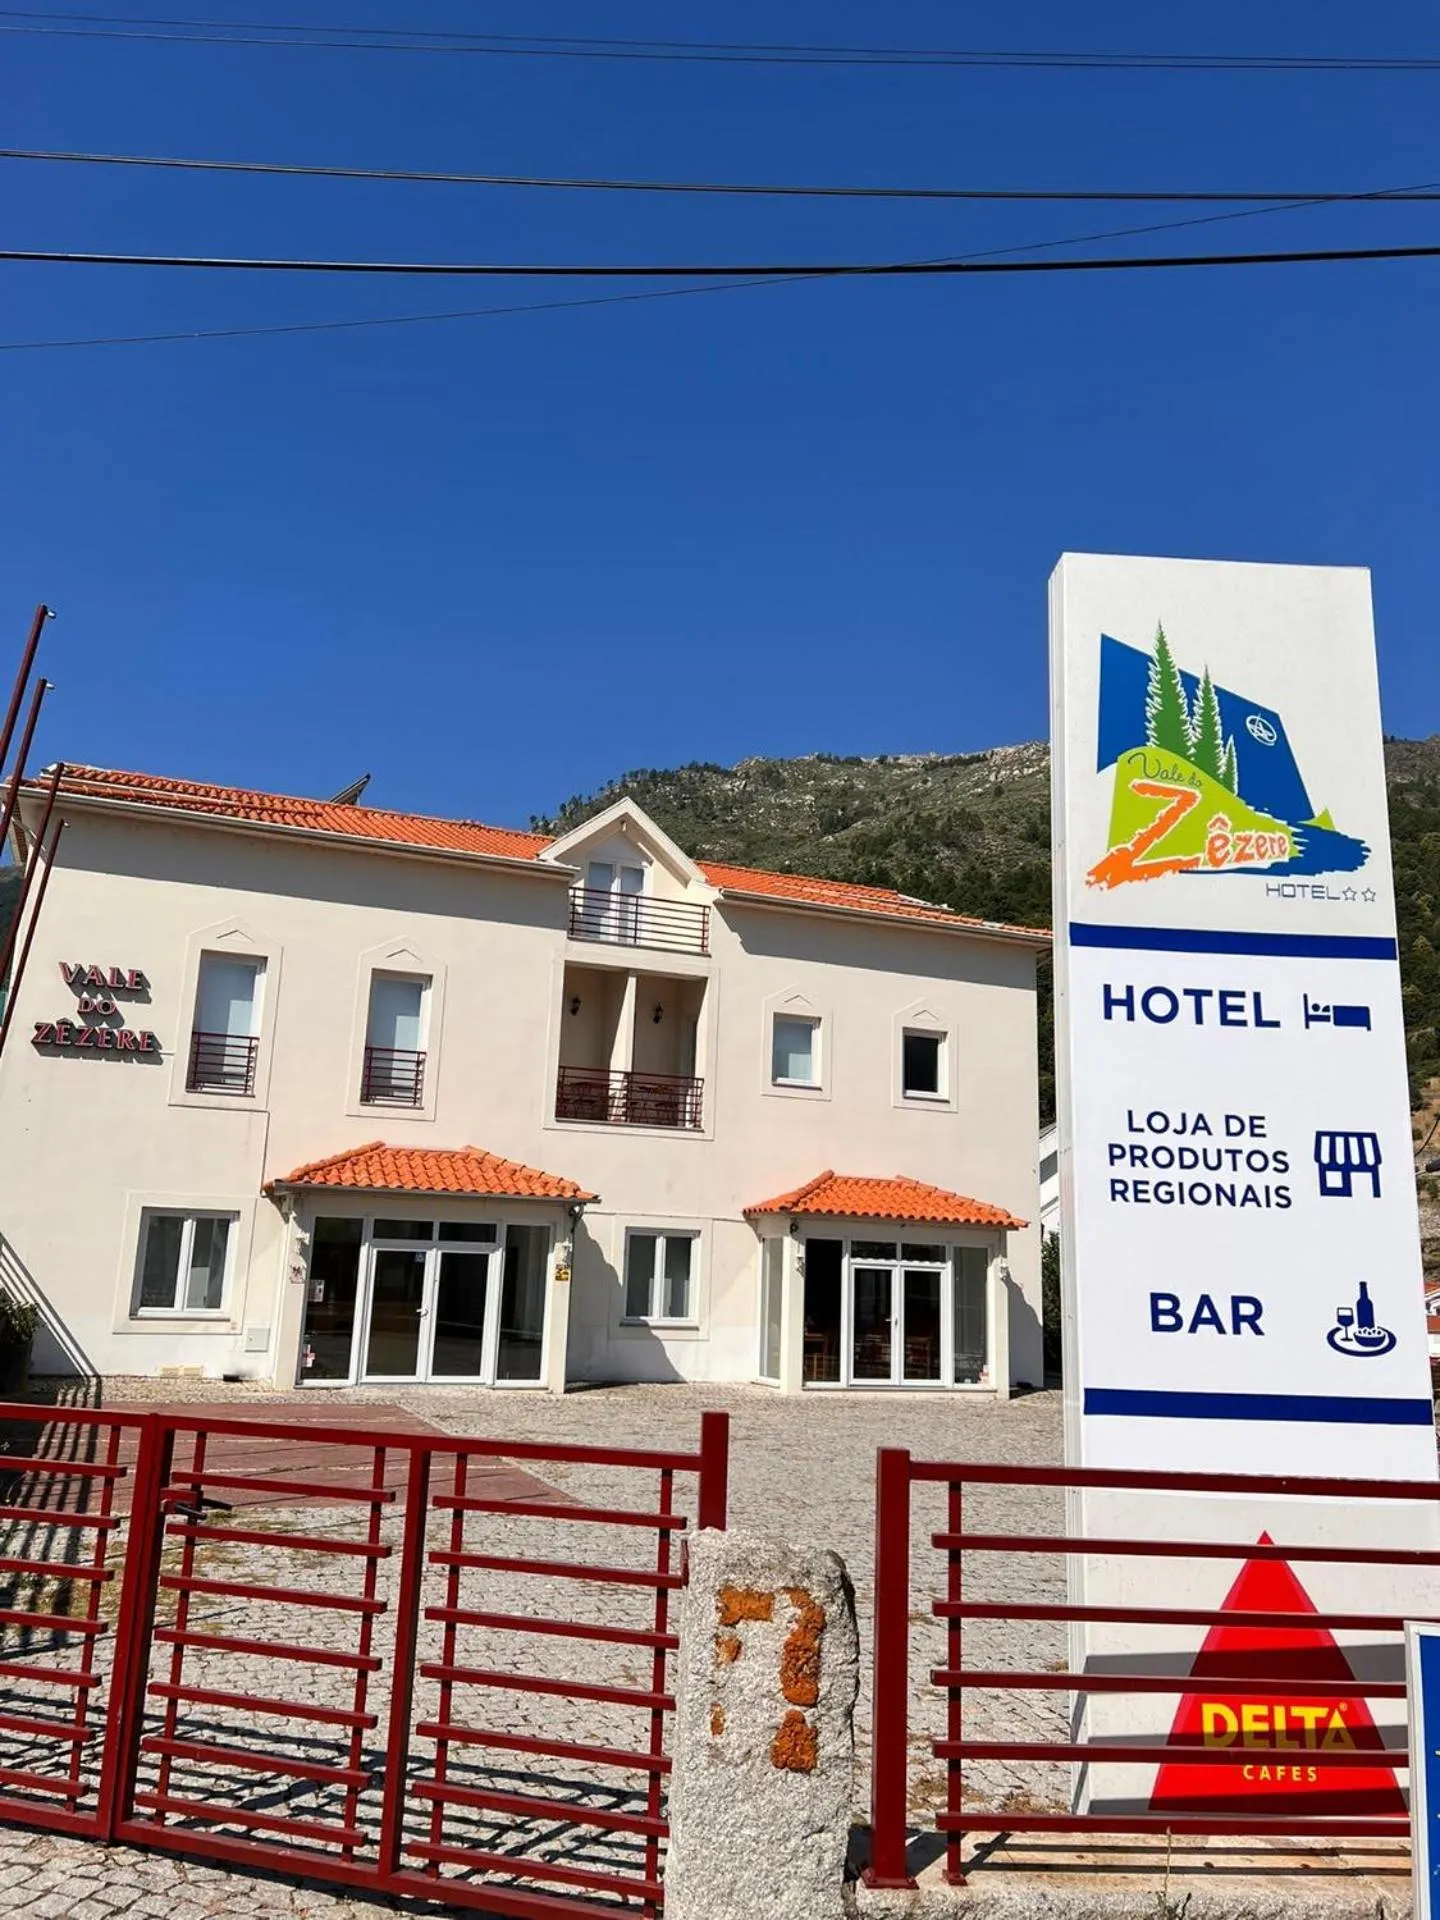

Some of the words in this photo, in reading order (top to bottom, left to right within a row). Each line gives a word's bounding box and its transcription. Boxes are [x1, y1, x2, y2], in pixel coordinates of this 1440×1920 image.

[1127, 753, 1184, 782] Vale
[1085, 780, 1290, 891] Zêzere
[1266, 883, 1340, 900] HOTEL
[58, 961, 144, 989] VALE
[77, 996, 117, 1015] DO
[1103, 984, 1280, 1028] HOTEL
[32, 1018, 155, 1052] ZÊZERE
[1127, 1109, 1213, 1137] LOJA
[1224, 1114, 1267, 1138] DE
[1108, 1143, 1290, 1173] PRODUTOS
[1110, 1178, 1292, 1208] REGIONAIS
[1149, 1292, 1265, 1336] BAR
[1243, 1765, 1317, 1782] CAFES
